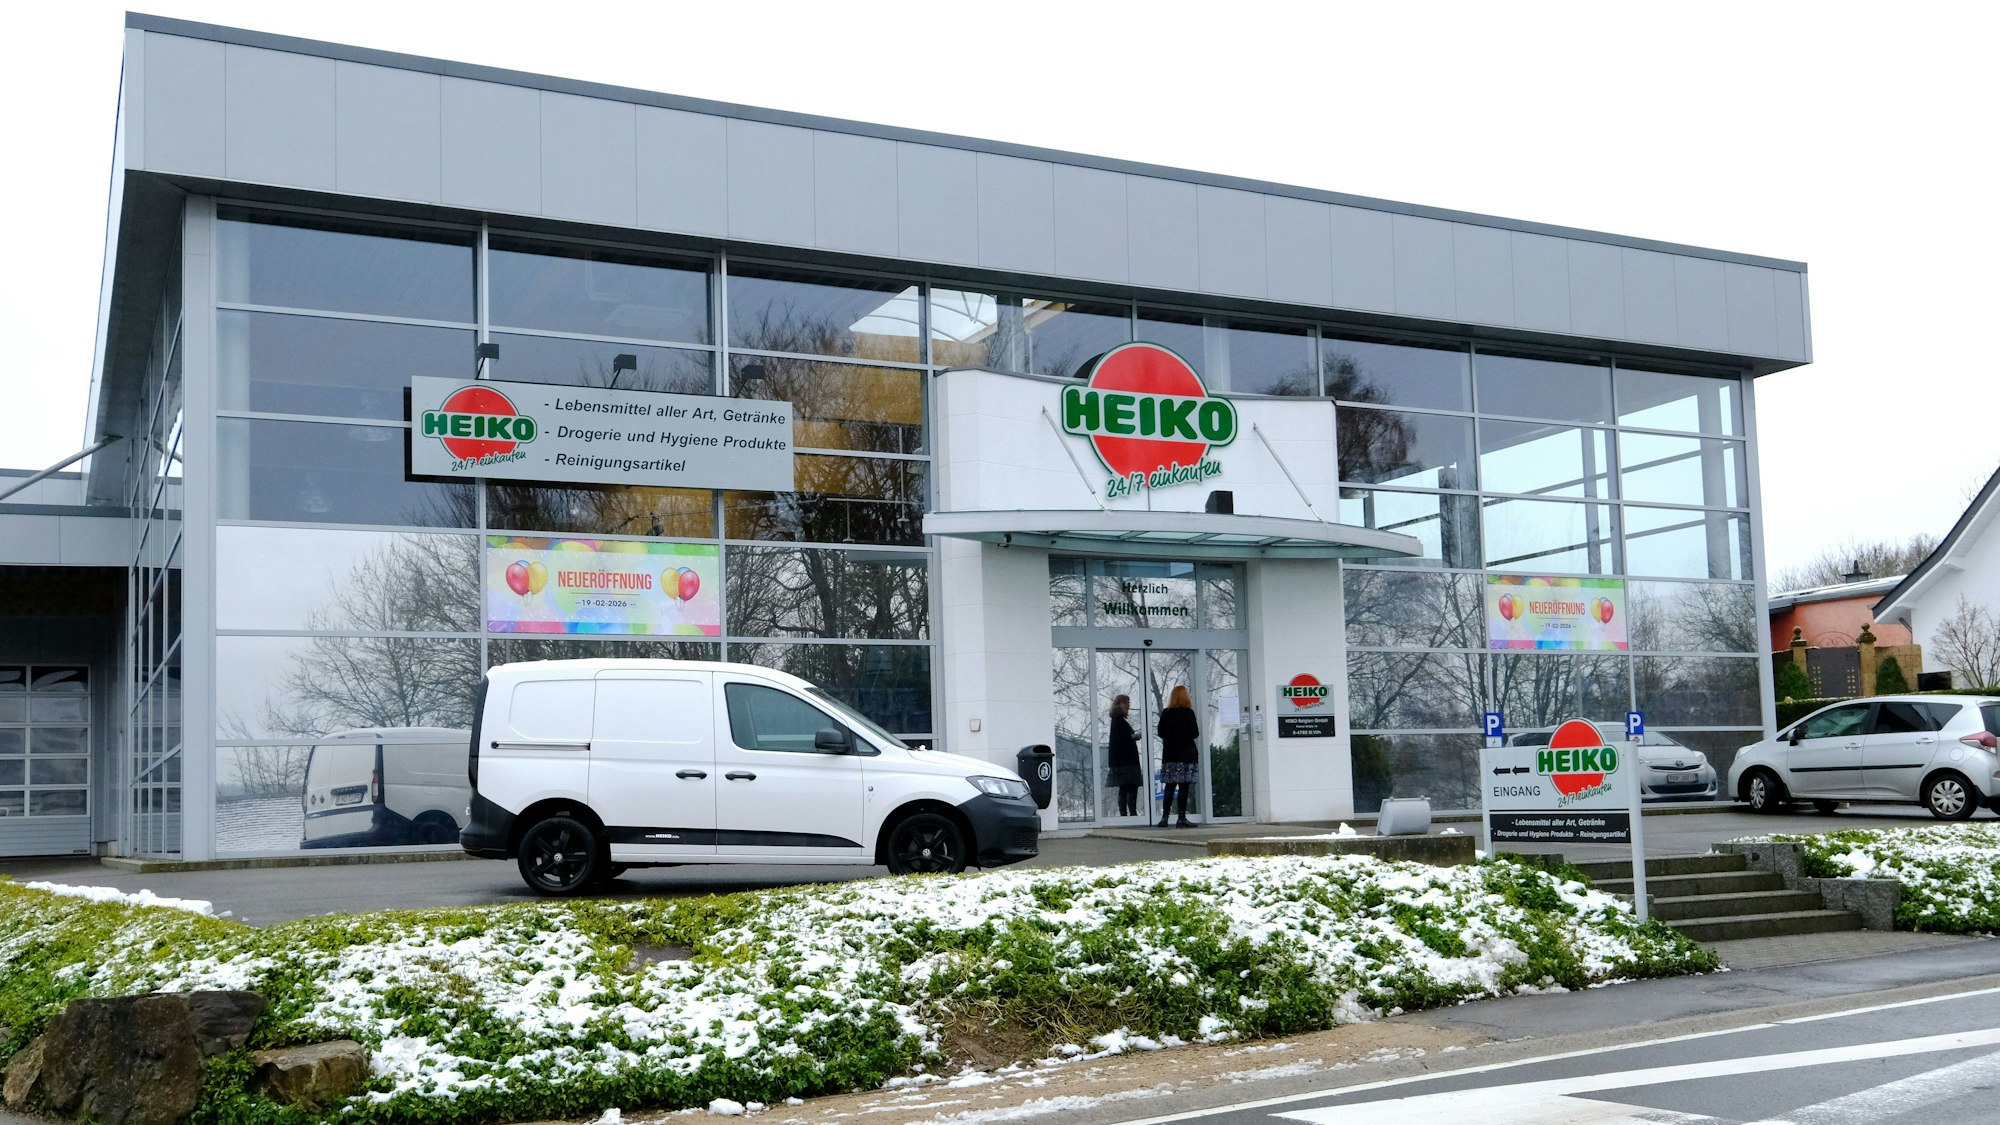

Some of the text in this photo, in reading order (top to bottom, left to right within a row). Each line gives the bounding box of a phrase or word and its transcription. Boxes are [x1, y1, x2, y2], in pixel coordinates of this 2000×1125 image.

[555, 398, 652, 416] Lebensmittel
[656, 405, 688, 418] aller
[692, 407, 717, 422] Art,
[723, 409, 786, 424] Getränke
[1065, 388, 1233, 441] HEIKO
[424, 412, 535, 441] HEIKO
[557, 425, 622, 442] Drogerie
[627, 431, 655, 443] und
[660, 431, 718, 448] Hygiene
[723, 435, 786, 450] Produkte
[451, 449, 527, 472] 24/7 einkaufen
[555, 453, 686, 472] Reinigungsartikel
[1107, 457, 1222, 498] 24/7 einkaufen
[557, 569, 652, 590] NEUERÖFFNUNG
[1122, 583, 1169, 594] Herzlich
[1103, 603, 1188, 617] Willkommen
[1529, 600, 1586, 616] NEUERÖFFNUNG
[1283, 686, 1328, 697] HEIKO
[1486, 715, 1500, 735] P
[1629, 713, 1642, 734] P
[1537, 747, 1617, 773] HEIKO
[1493, 785, 1541, 797] EINGANG
[1557, 783, 1613, 808] 24/7 einkaufen
[1515, 818, 1551, 826] Lebensmittel
[1552, 818, 1565, 826] aller
[1566, 818, 1577, 827] Art,
[1578, 818, 1606, 826] Getränke
[1497, 830, 1518, 838] Drogerie
[1529, 830, 1550, 838] Hygiene
[1580, 830, 1627, 839] Reinigungsartikel
